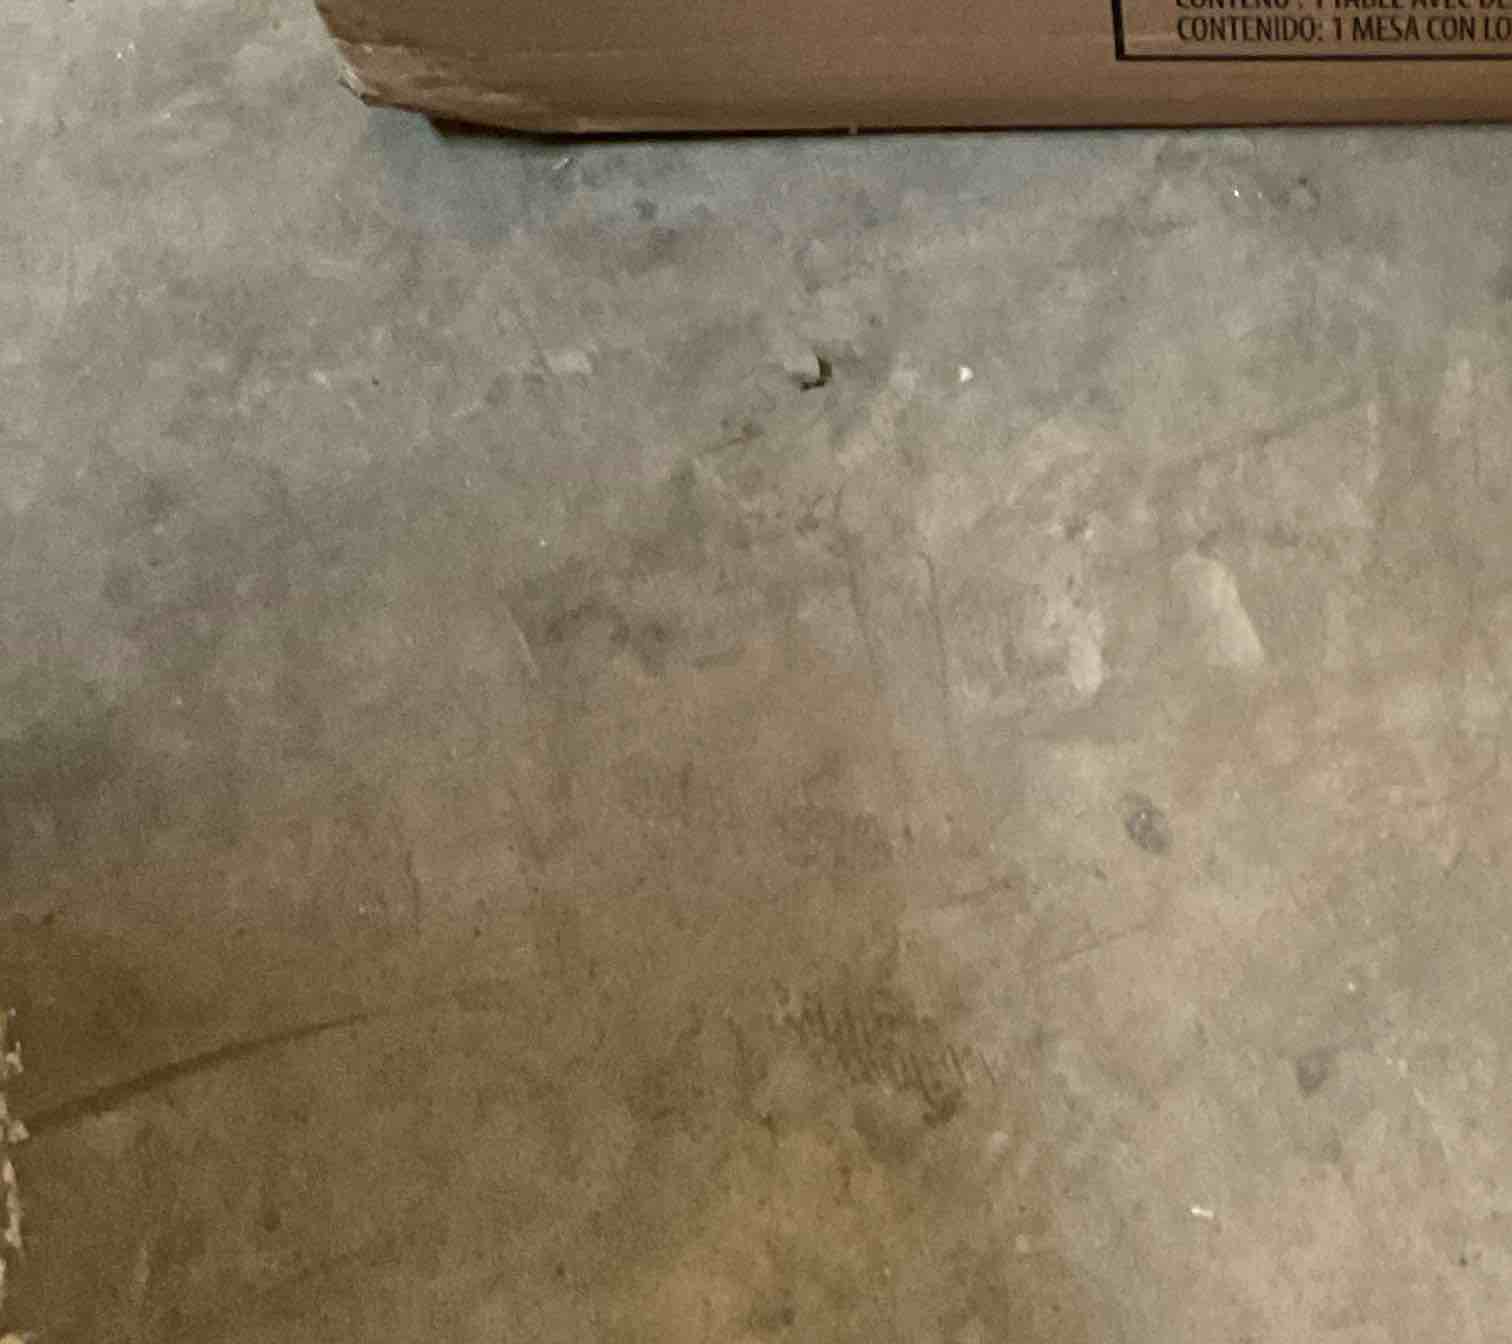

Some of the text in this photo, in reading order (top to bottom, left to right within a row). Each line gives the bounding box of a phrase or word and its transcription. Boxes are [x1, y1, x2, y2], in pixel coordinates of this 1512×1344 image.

[1177, 16, 1324, 43] CONTENIDO:
[1333, 16, 1344, 42] 1
[1351, 16, 1421, 42] MESA
[1426, 16, 1476, 42] CON
